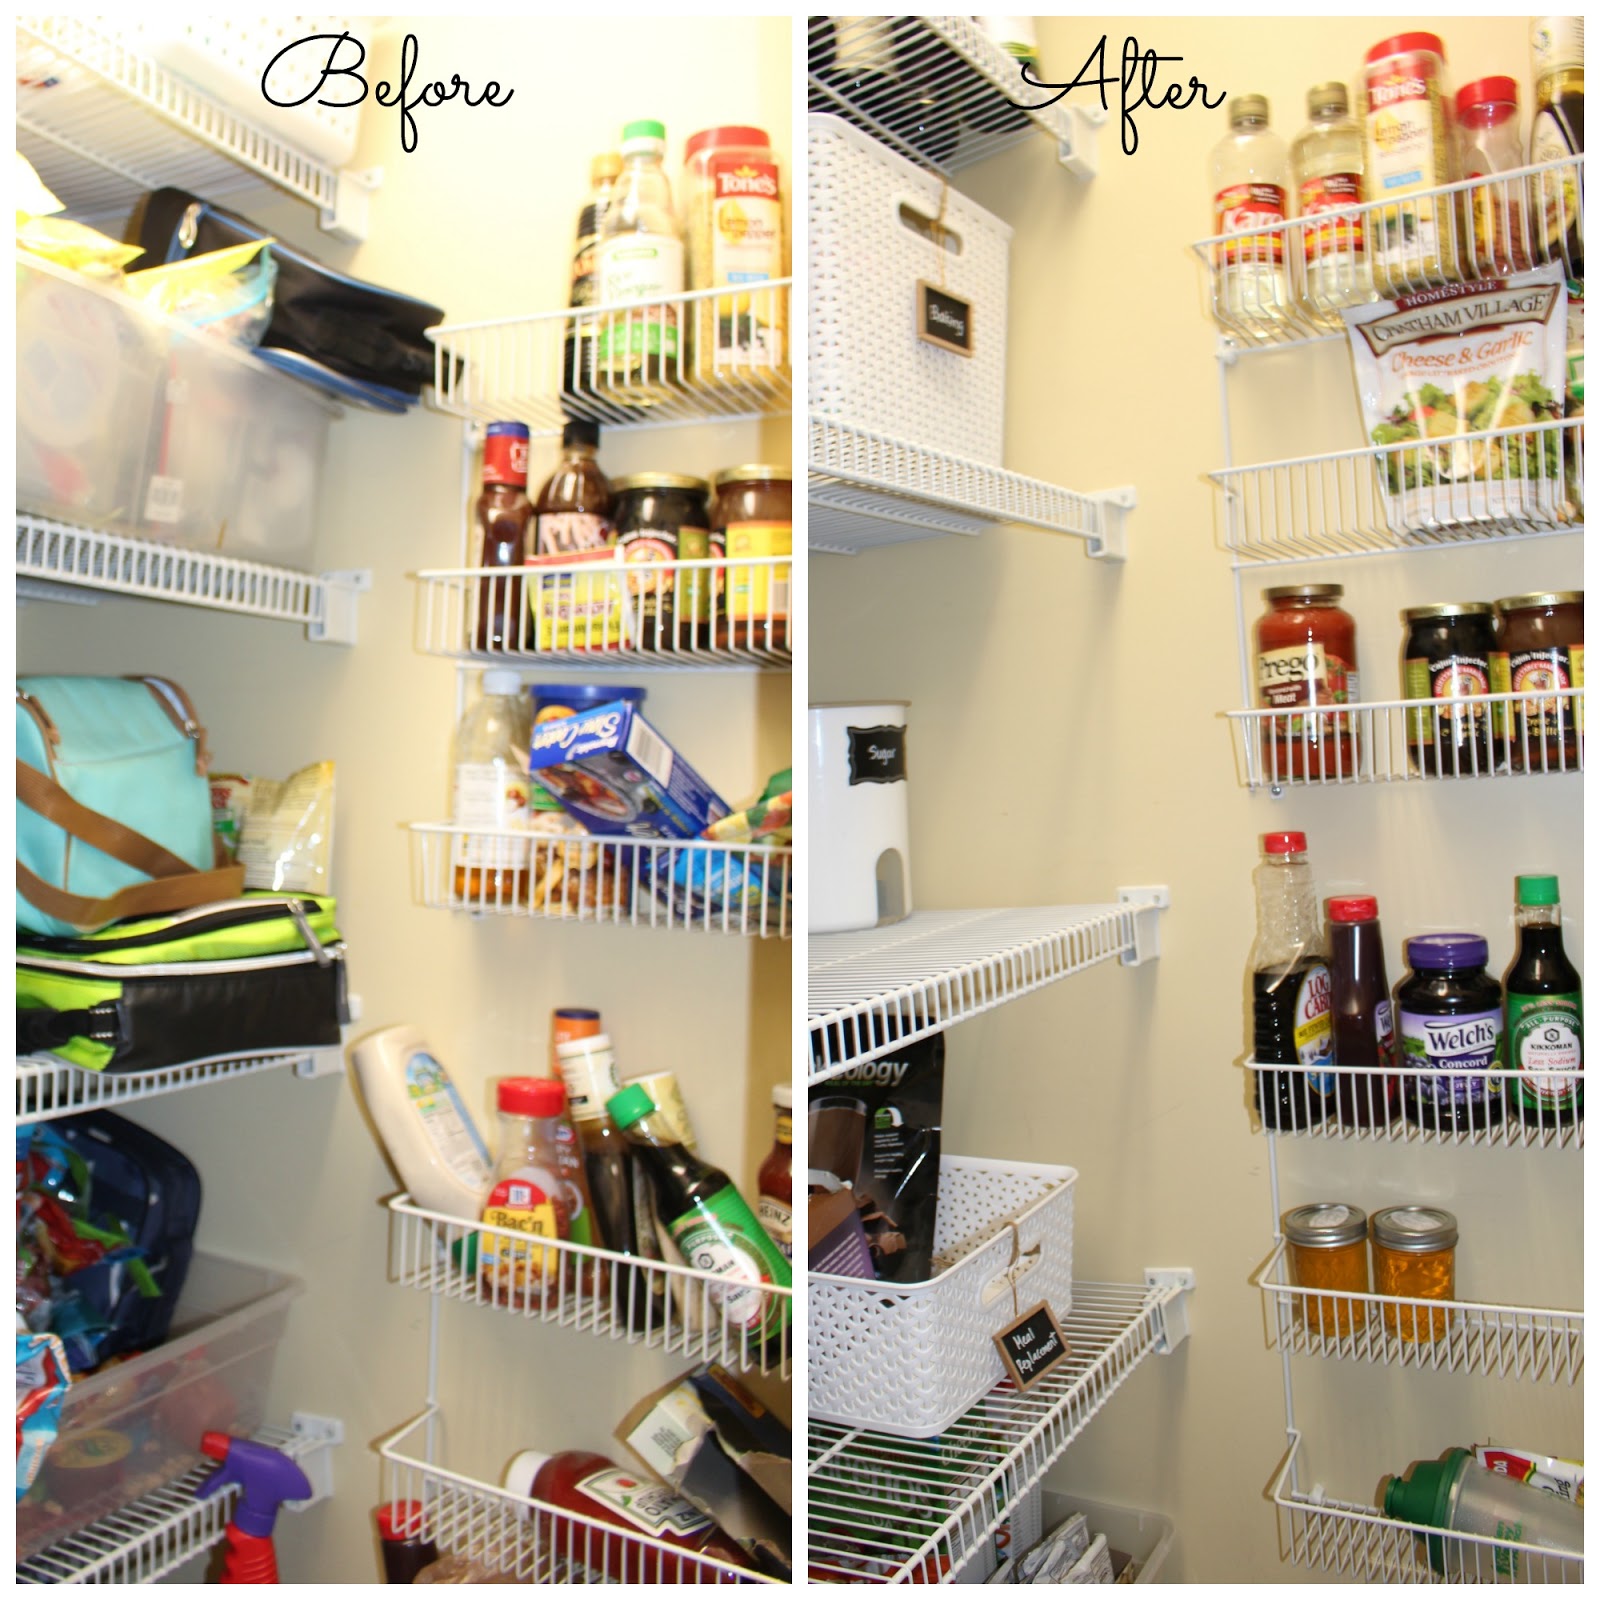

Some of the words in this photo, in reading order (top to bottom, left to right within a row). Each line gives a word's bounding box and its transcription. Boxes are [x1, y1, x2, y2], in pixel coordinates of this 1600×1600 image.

[717, 171, 777, 196] Tone's
[1405, 280, 1498, 308] HOMESTYLE
[1463, 293, 1546, 322] VILLAGE
[1391, 348, 1456, 374] Cheese
[1458, 346, 1473, 365] &
[1476, 330, 1533, 360] Garlic
[1259, 654, 1319, 682] Prego
[867, 743, 897, 767] Sugar
[1307, 972, 1331, 998] LOG
[1428, 1022, 1496, 1052] Welch's
[1530, 1042, 1574, 1051] KIKKOMAN
[1438, 1055, 1489, 1070] Concord
[759, 1203, 792, 1227] HEINZ
[1012, 1327, 1036, 1351] Meal
[1015, 1330, 1059, 1375] Replacement
